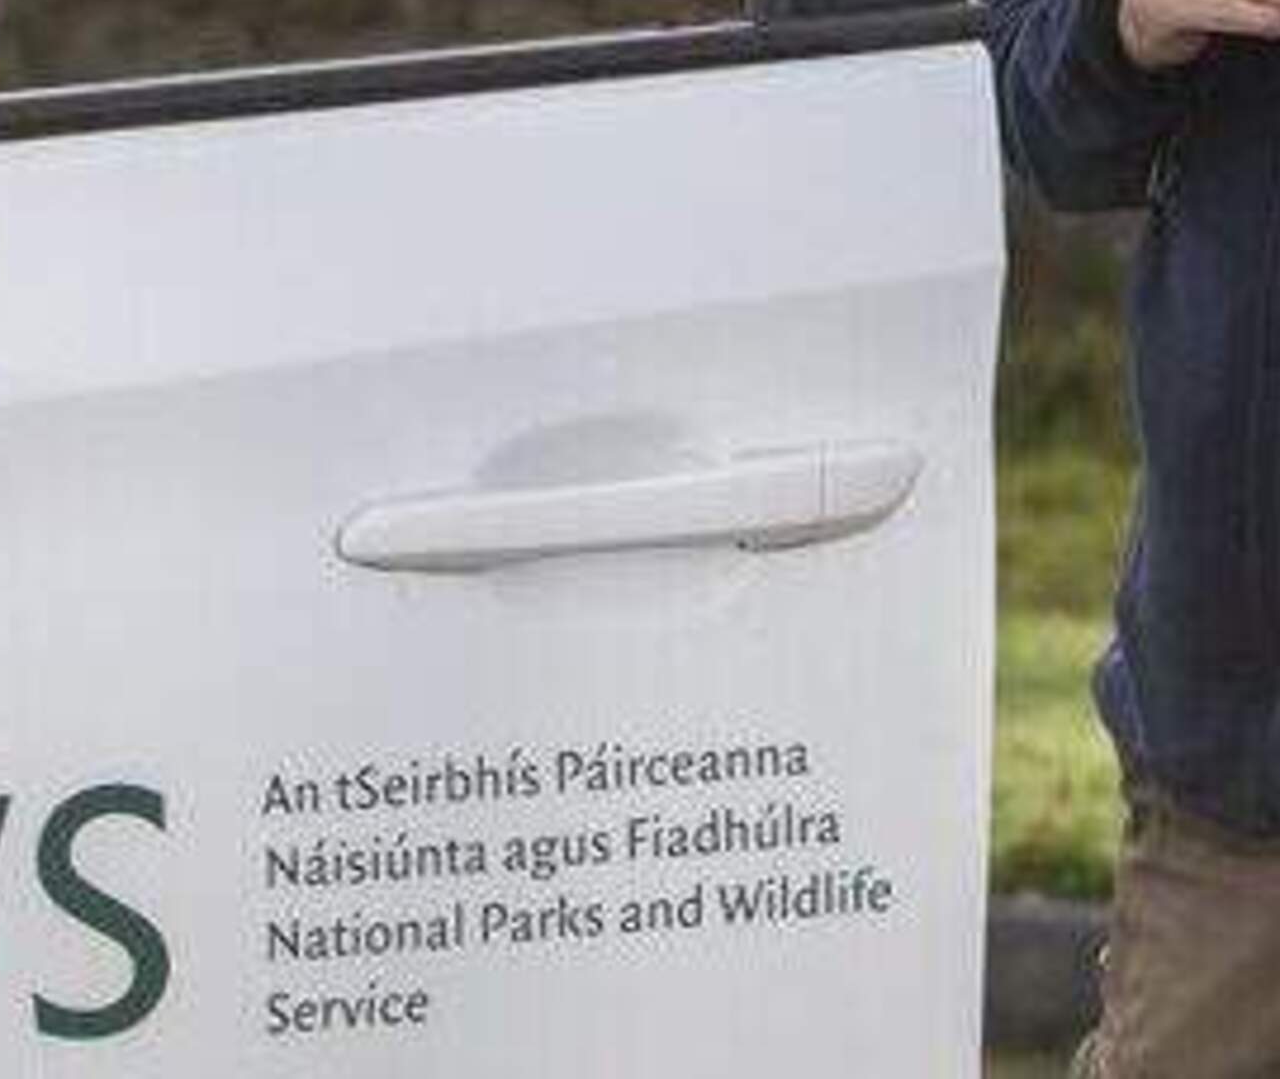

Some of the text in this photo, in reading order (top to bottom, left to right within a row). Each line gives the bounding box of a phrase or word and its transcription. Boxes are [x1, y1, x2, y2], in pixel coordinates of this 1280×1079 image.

[262, 741, 810, 815] An tSeirbhís Páirceanna
[265, 803, 840, 888] Náisiúnta agus Fiadhúlra
[268, 865, 892, 961] National Parks and Wildlife
[268, 982, 428, 1035] Service
